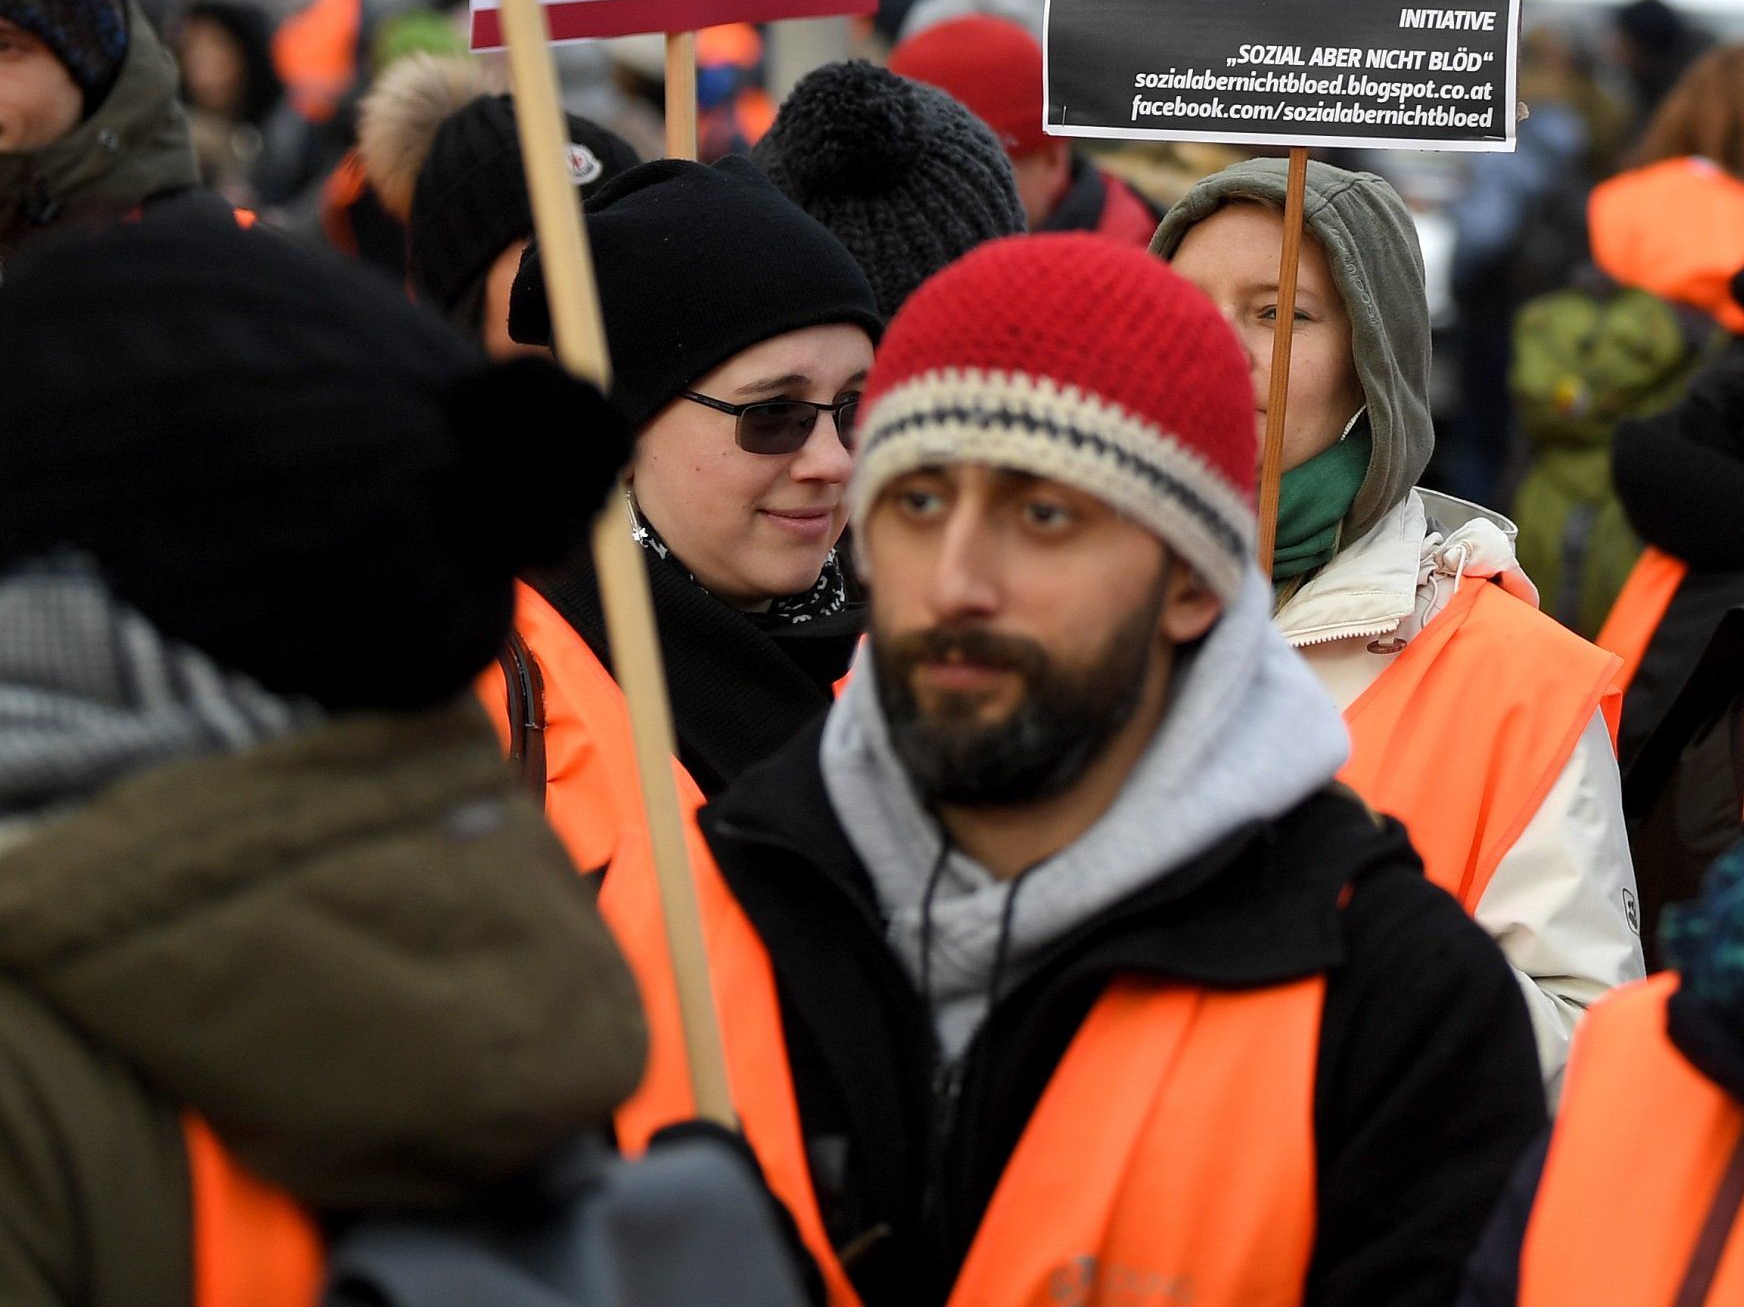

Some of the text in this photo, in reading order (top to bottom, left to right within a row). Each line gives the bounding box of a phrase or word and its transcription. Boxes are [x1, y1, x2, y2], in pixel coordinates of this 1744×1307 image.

[1399, 8, 1496, 31] INITIATIVE
[1309, 49, 1361, 68] ABER
[1365, 49, 1425, 71] NICHT
[1134, 68, 1493, 103] sozialabernichtbloed.blogspot.co.at
[1130, 95, 1494, 129] facebook.com/sozialabernichtbloed
